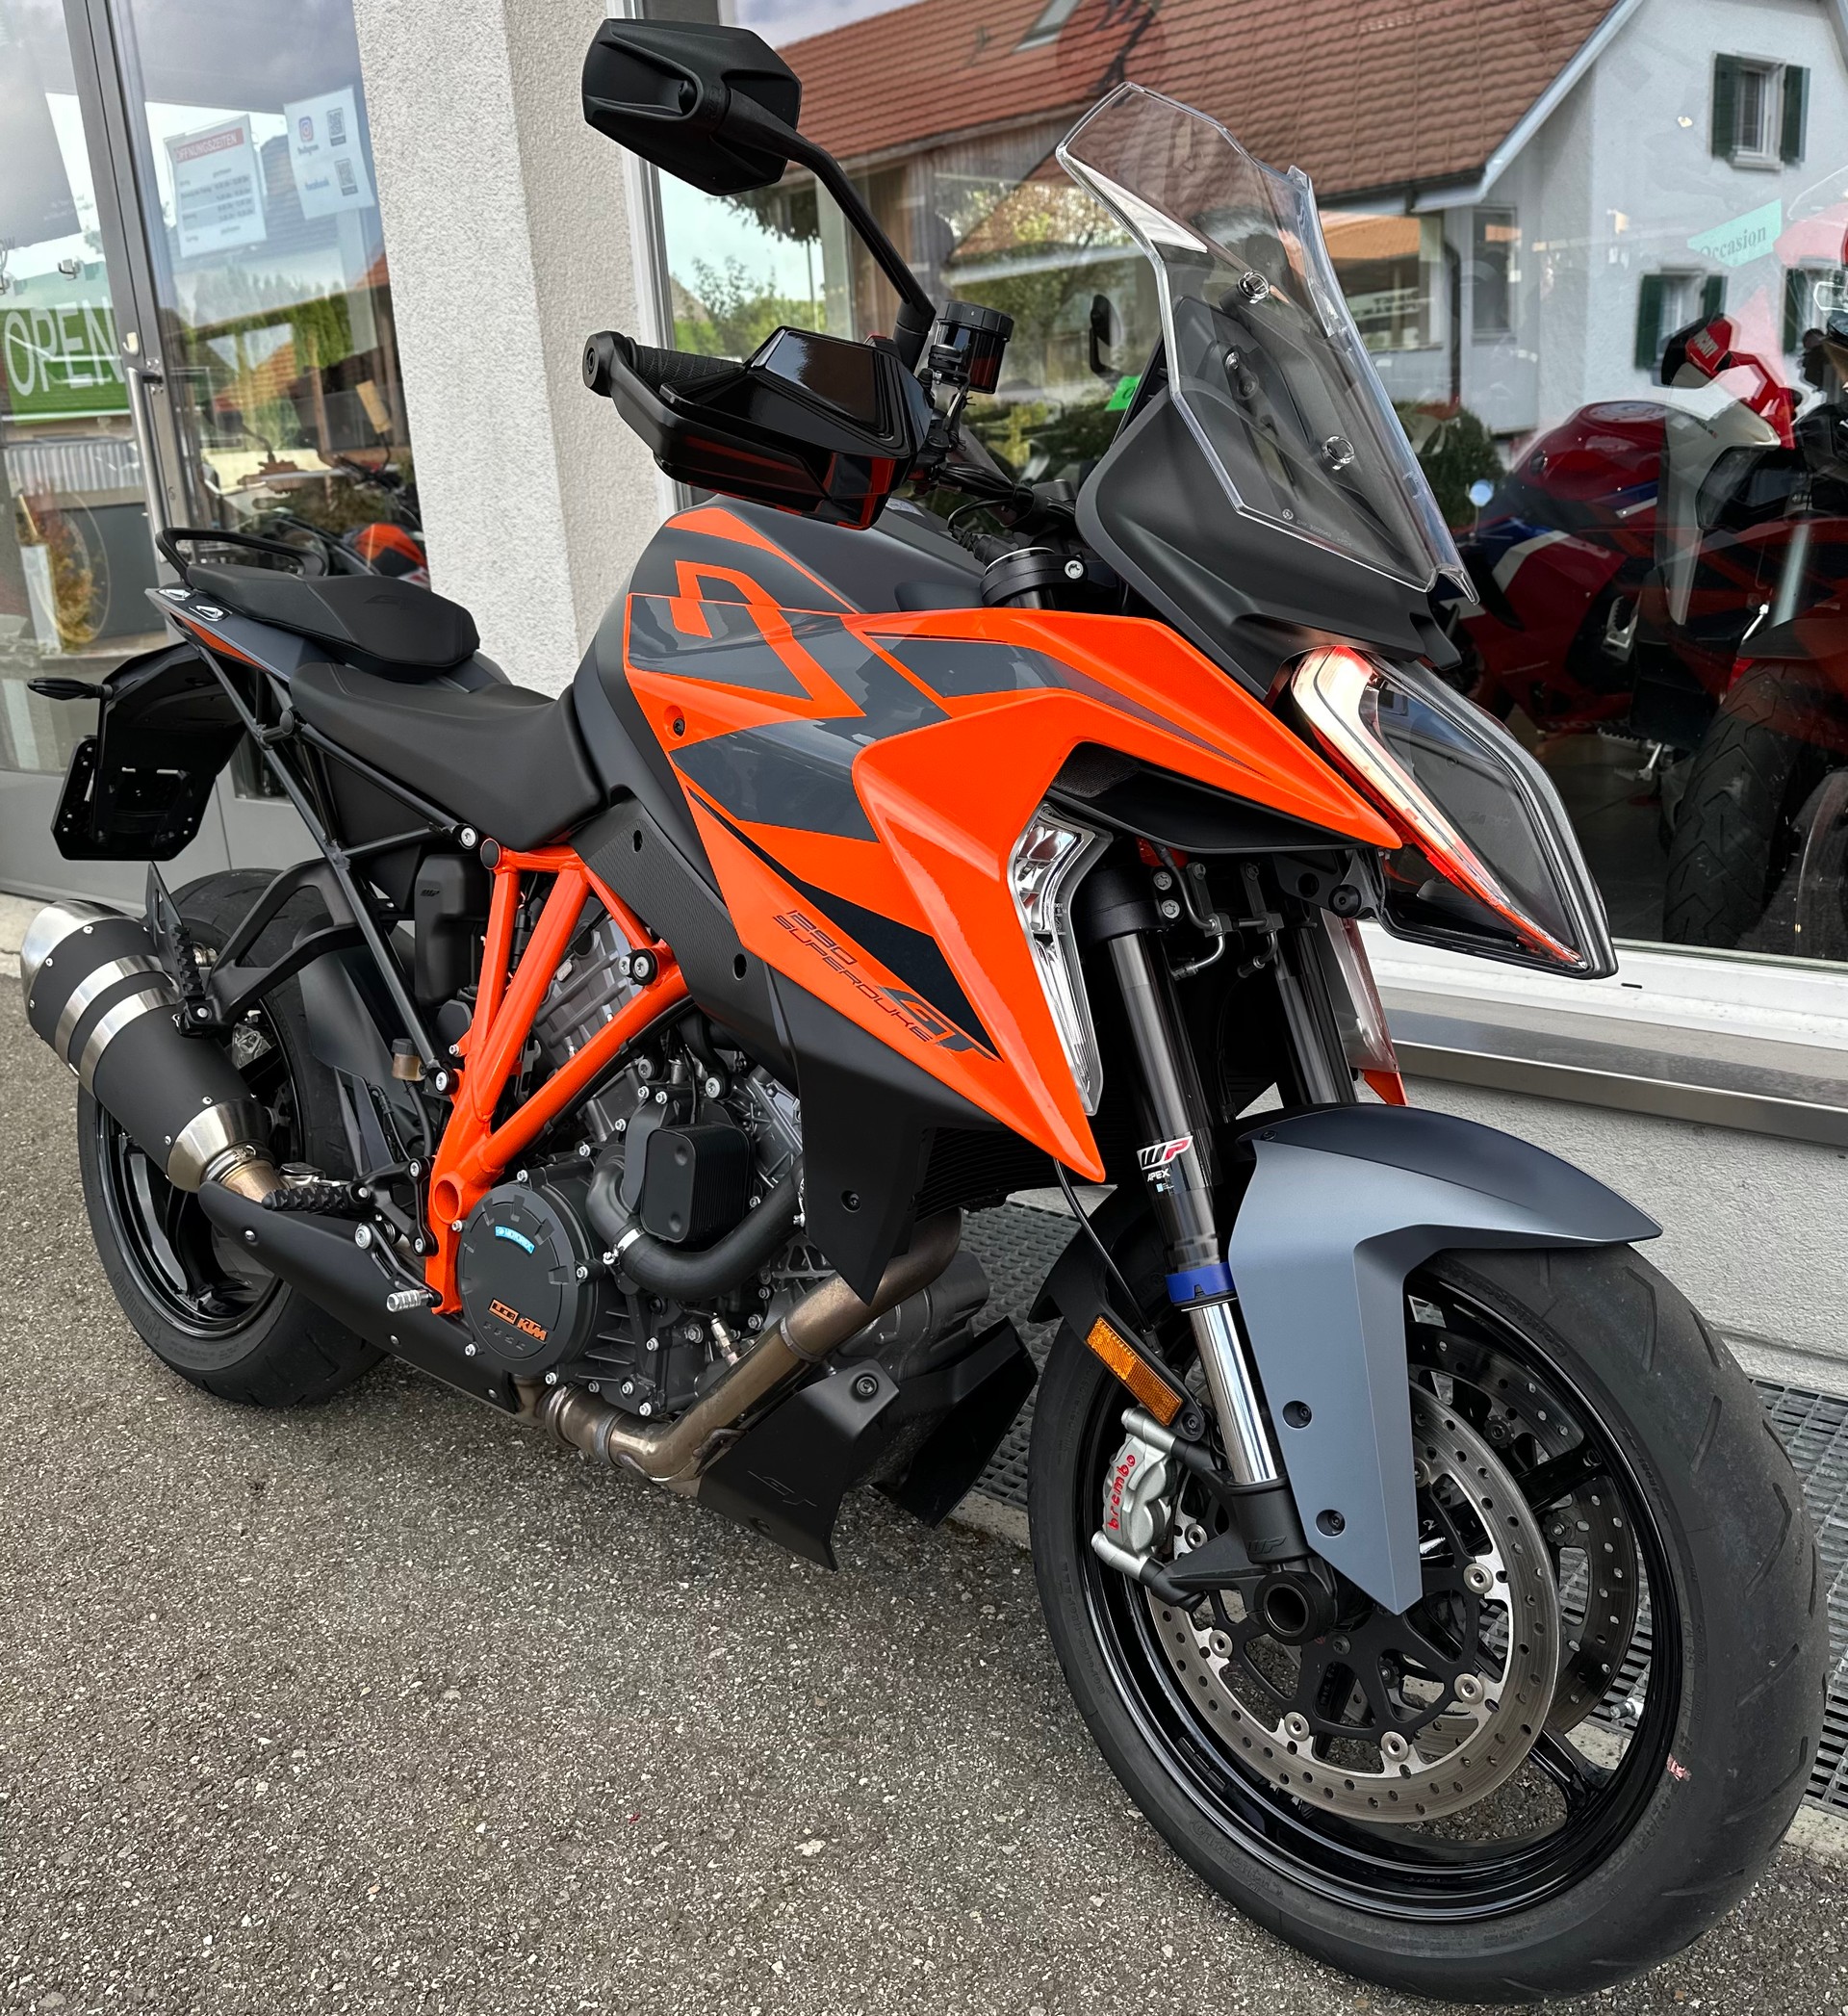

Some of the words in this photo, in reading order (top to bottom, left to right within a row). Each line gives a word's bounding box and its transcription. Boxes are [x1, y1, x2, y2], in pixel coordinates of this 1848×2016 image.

[4, 297, 125, 396] OPEN
[786, 910, 858, 966] 1290
[1147, 1168, 1170, 1182] APEX
[516, 1317, 549, 1342] KTM
[1107, 1454, 1136, 1531] brembo
